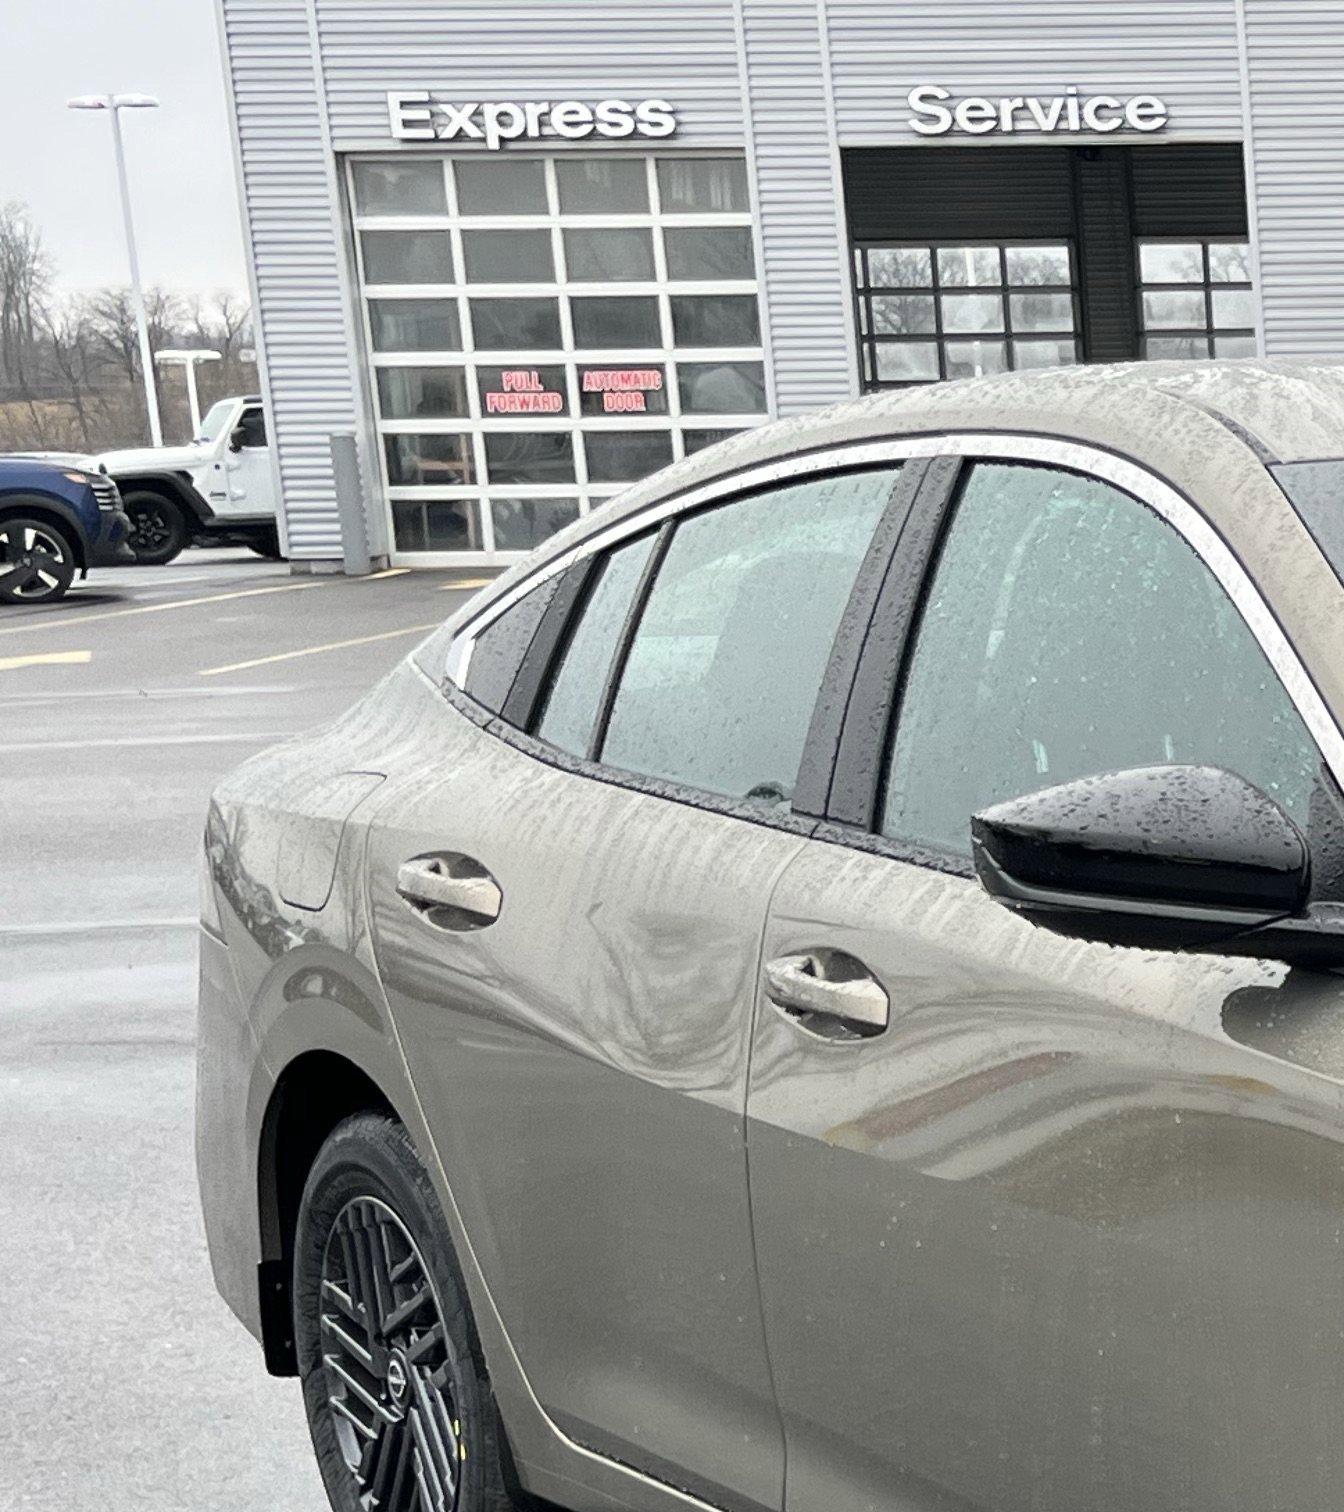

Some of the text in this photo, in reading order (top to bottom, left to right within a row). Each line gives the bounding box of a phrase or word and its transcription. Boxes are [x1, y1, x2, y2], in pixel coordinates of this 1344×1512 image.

[387, 91, 676, 149] Express
[908, 86, 1168, 134] Service
[502, 371, 544, 391] PULL
[583, 370, 662, 391] AUTOMATIC
[484, 392, 563, 413] FORWARD
[603, 391, 646, 412] DOOR
